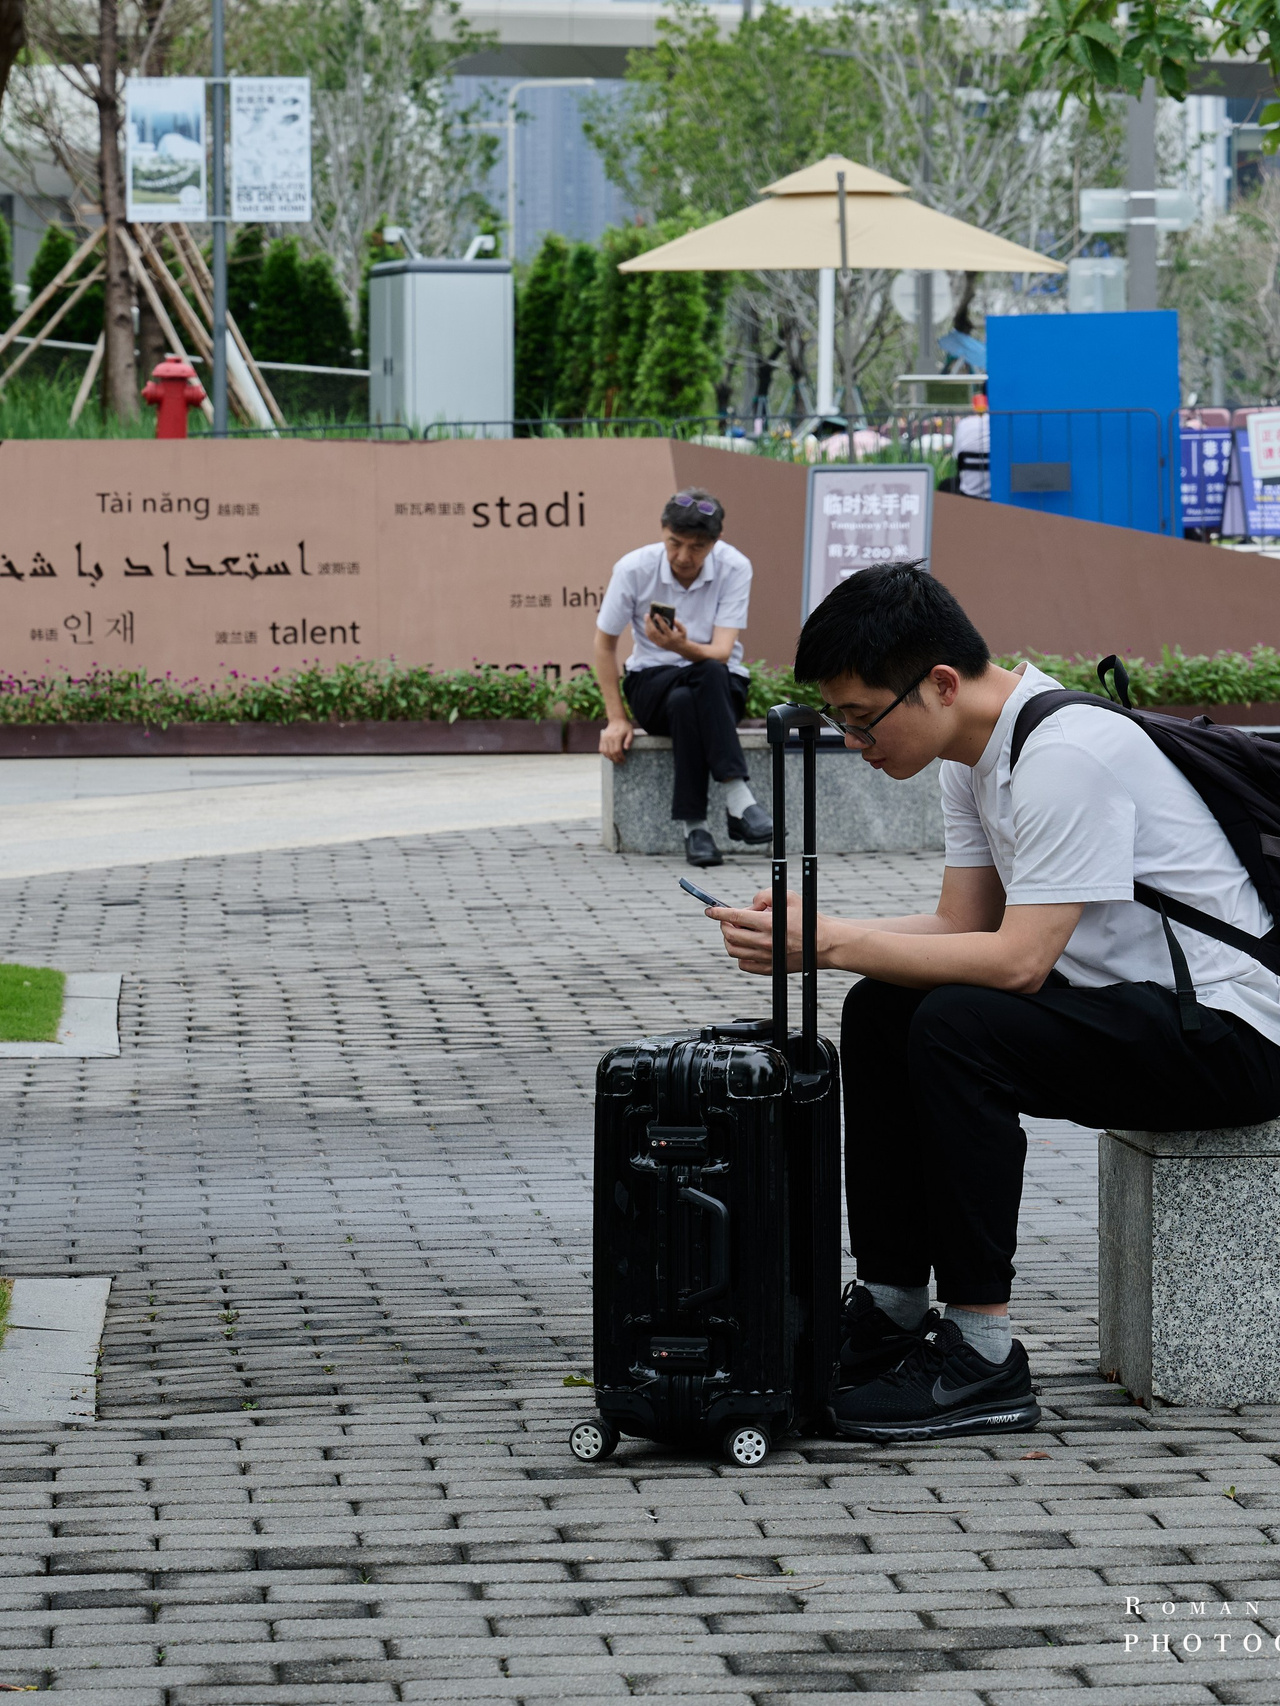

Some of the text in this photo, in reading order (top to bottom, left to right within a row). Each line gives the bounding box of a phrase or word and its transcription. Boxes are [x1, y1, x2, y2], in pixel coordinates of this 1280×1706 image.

[96, 492, 210, 520] Tài năng
[217, 503, 260, 517] 越南语
[394, 502, 466, 516] 斯瓦希里语
[472, 491, 586, 528] stadi
[823, 493, 919, 516] 临时洗手间
[318, 561, 361, 576] 波斯语
[509, 593, 552, 608] 芬兰语
[30, 627, 58, 642] 韩语
[215, 630, 258, 645] 波兰语
[269, 618, 361, 645] talent
